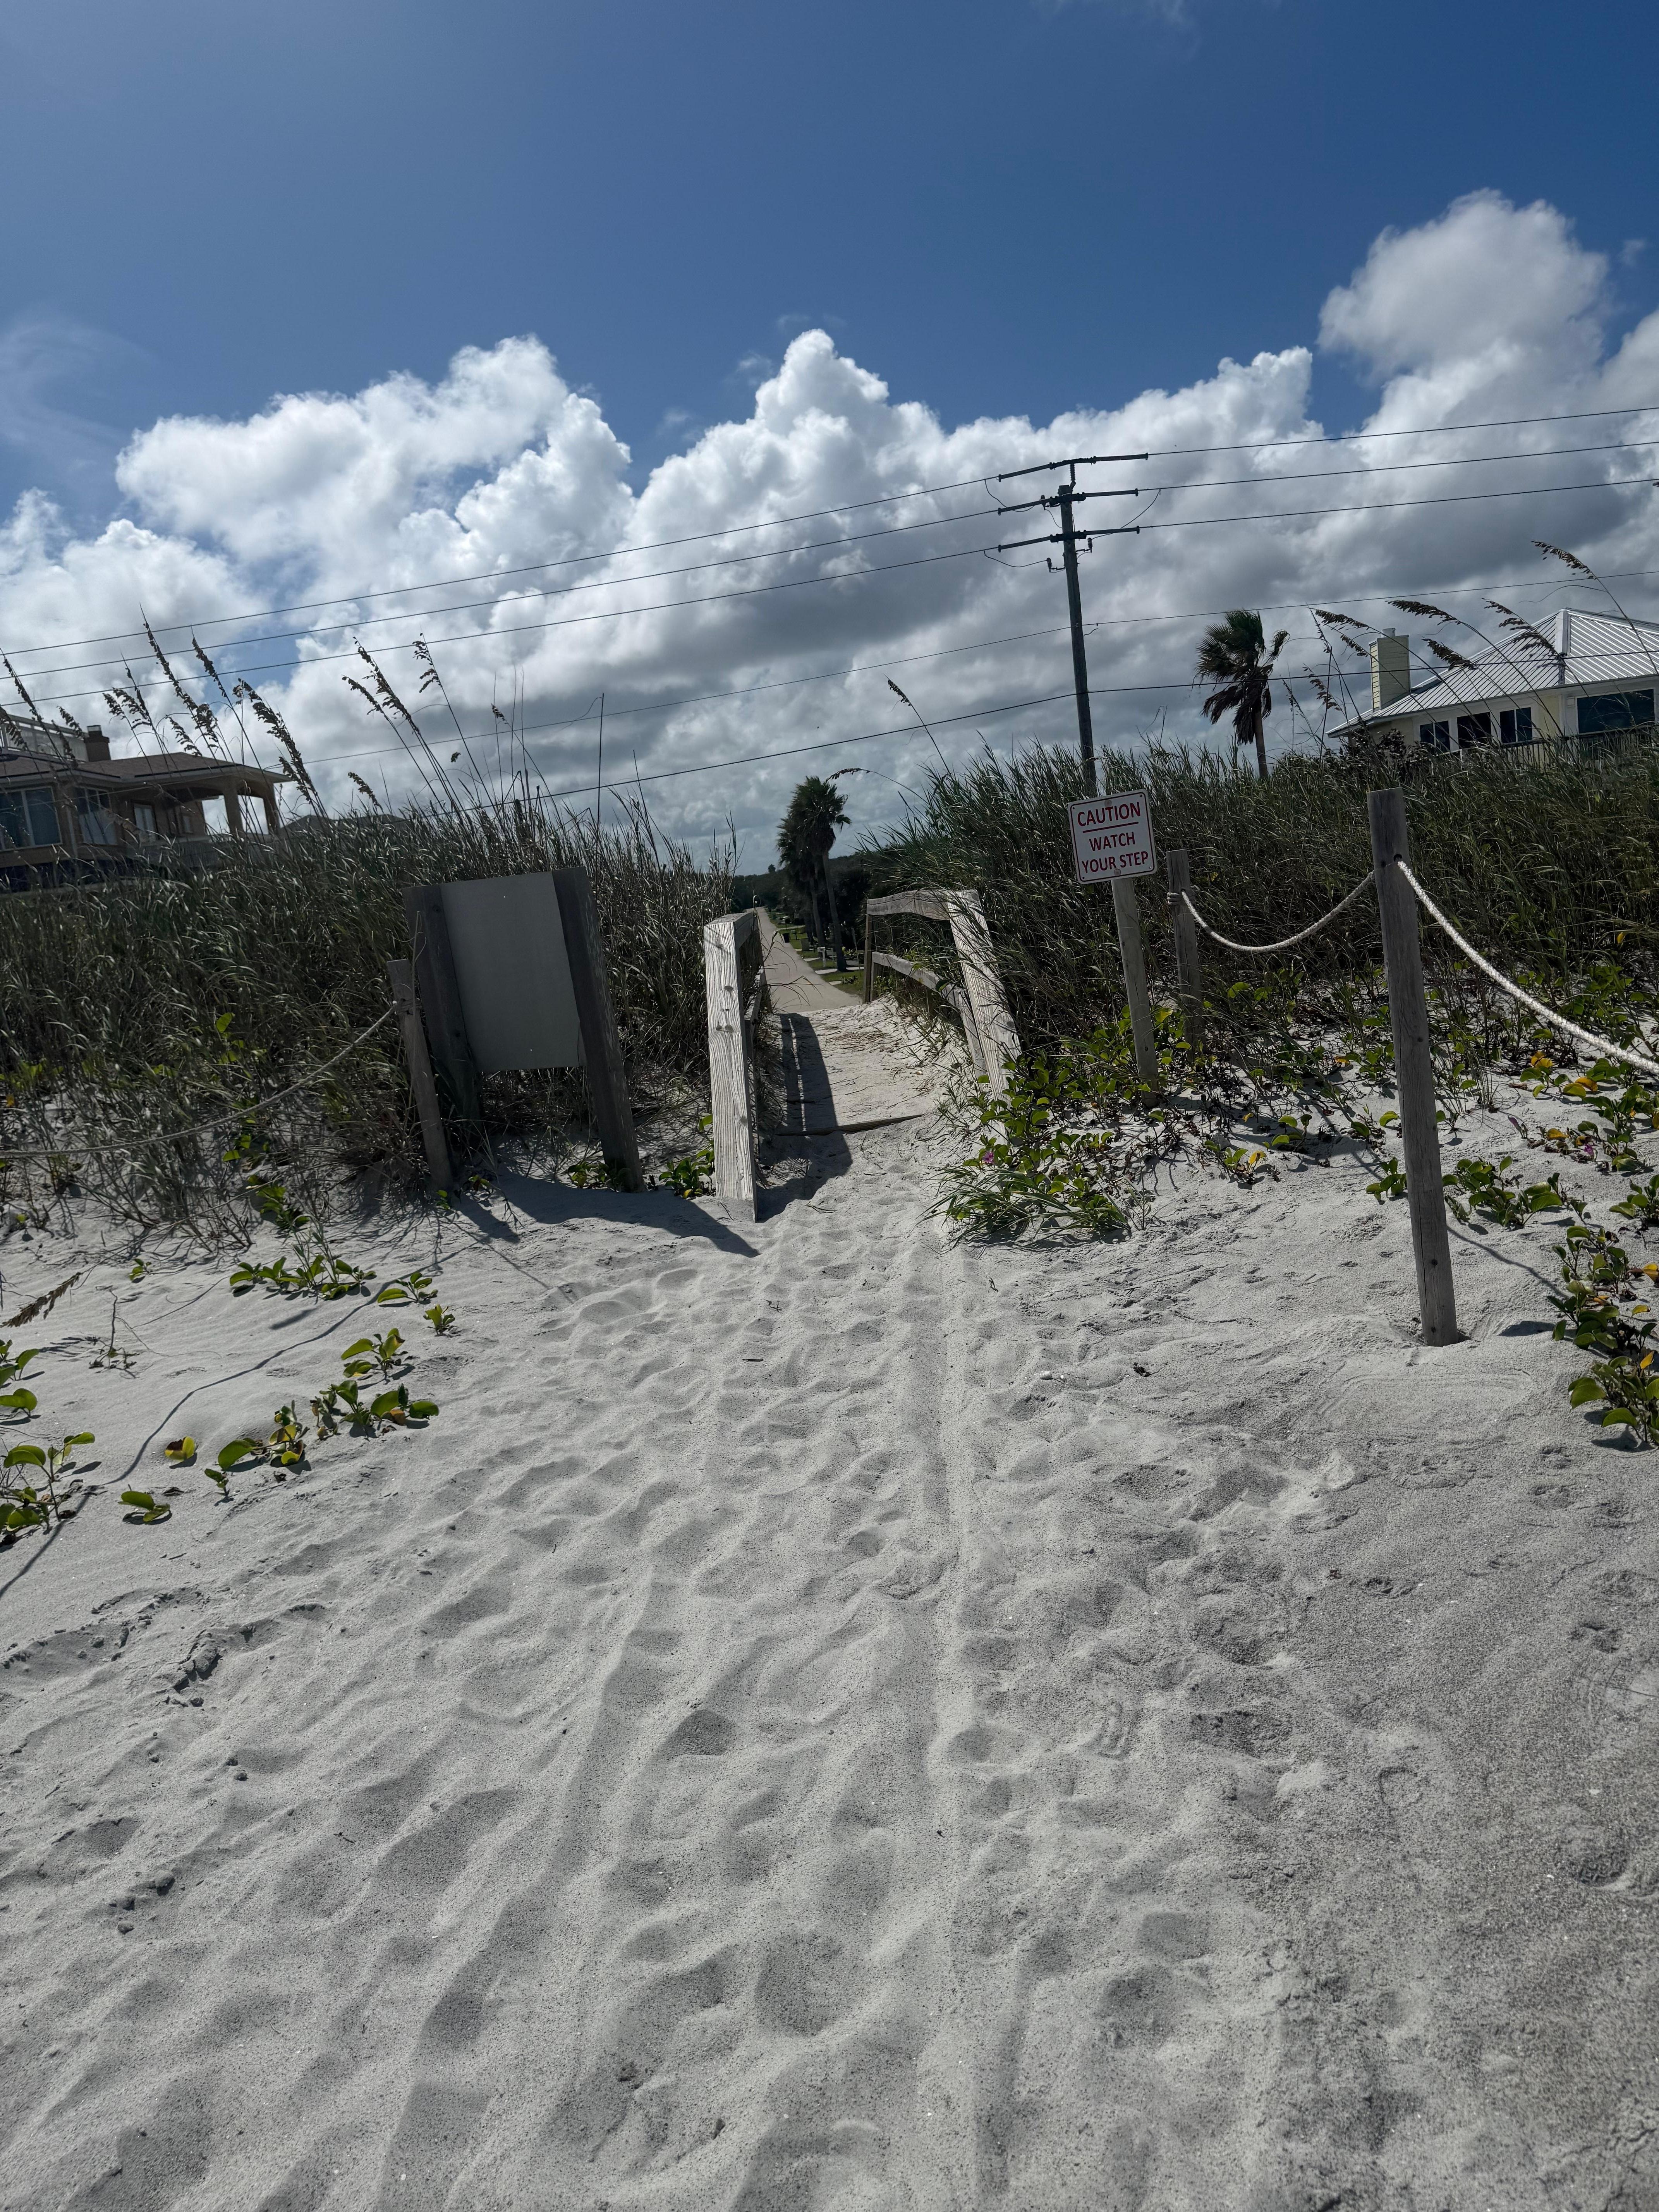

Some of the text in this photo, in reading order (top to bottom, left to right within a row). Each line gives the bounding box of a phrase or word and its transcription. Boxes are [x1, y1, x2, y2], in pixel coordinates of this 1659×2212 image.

[1077, 802, 1141, 826] CAUTION
[1089, 831, 1135, 851] WATCH
[1082, 851, 1148, 873] YOUR STEP
